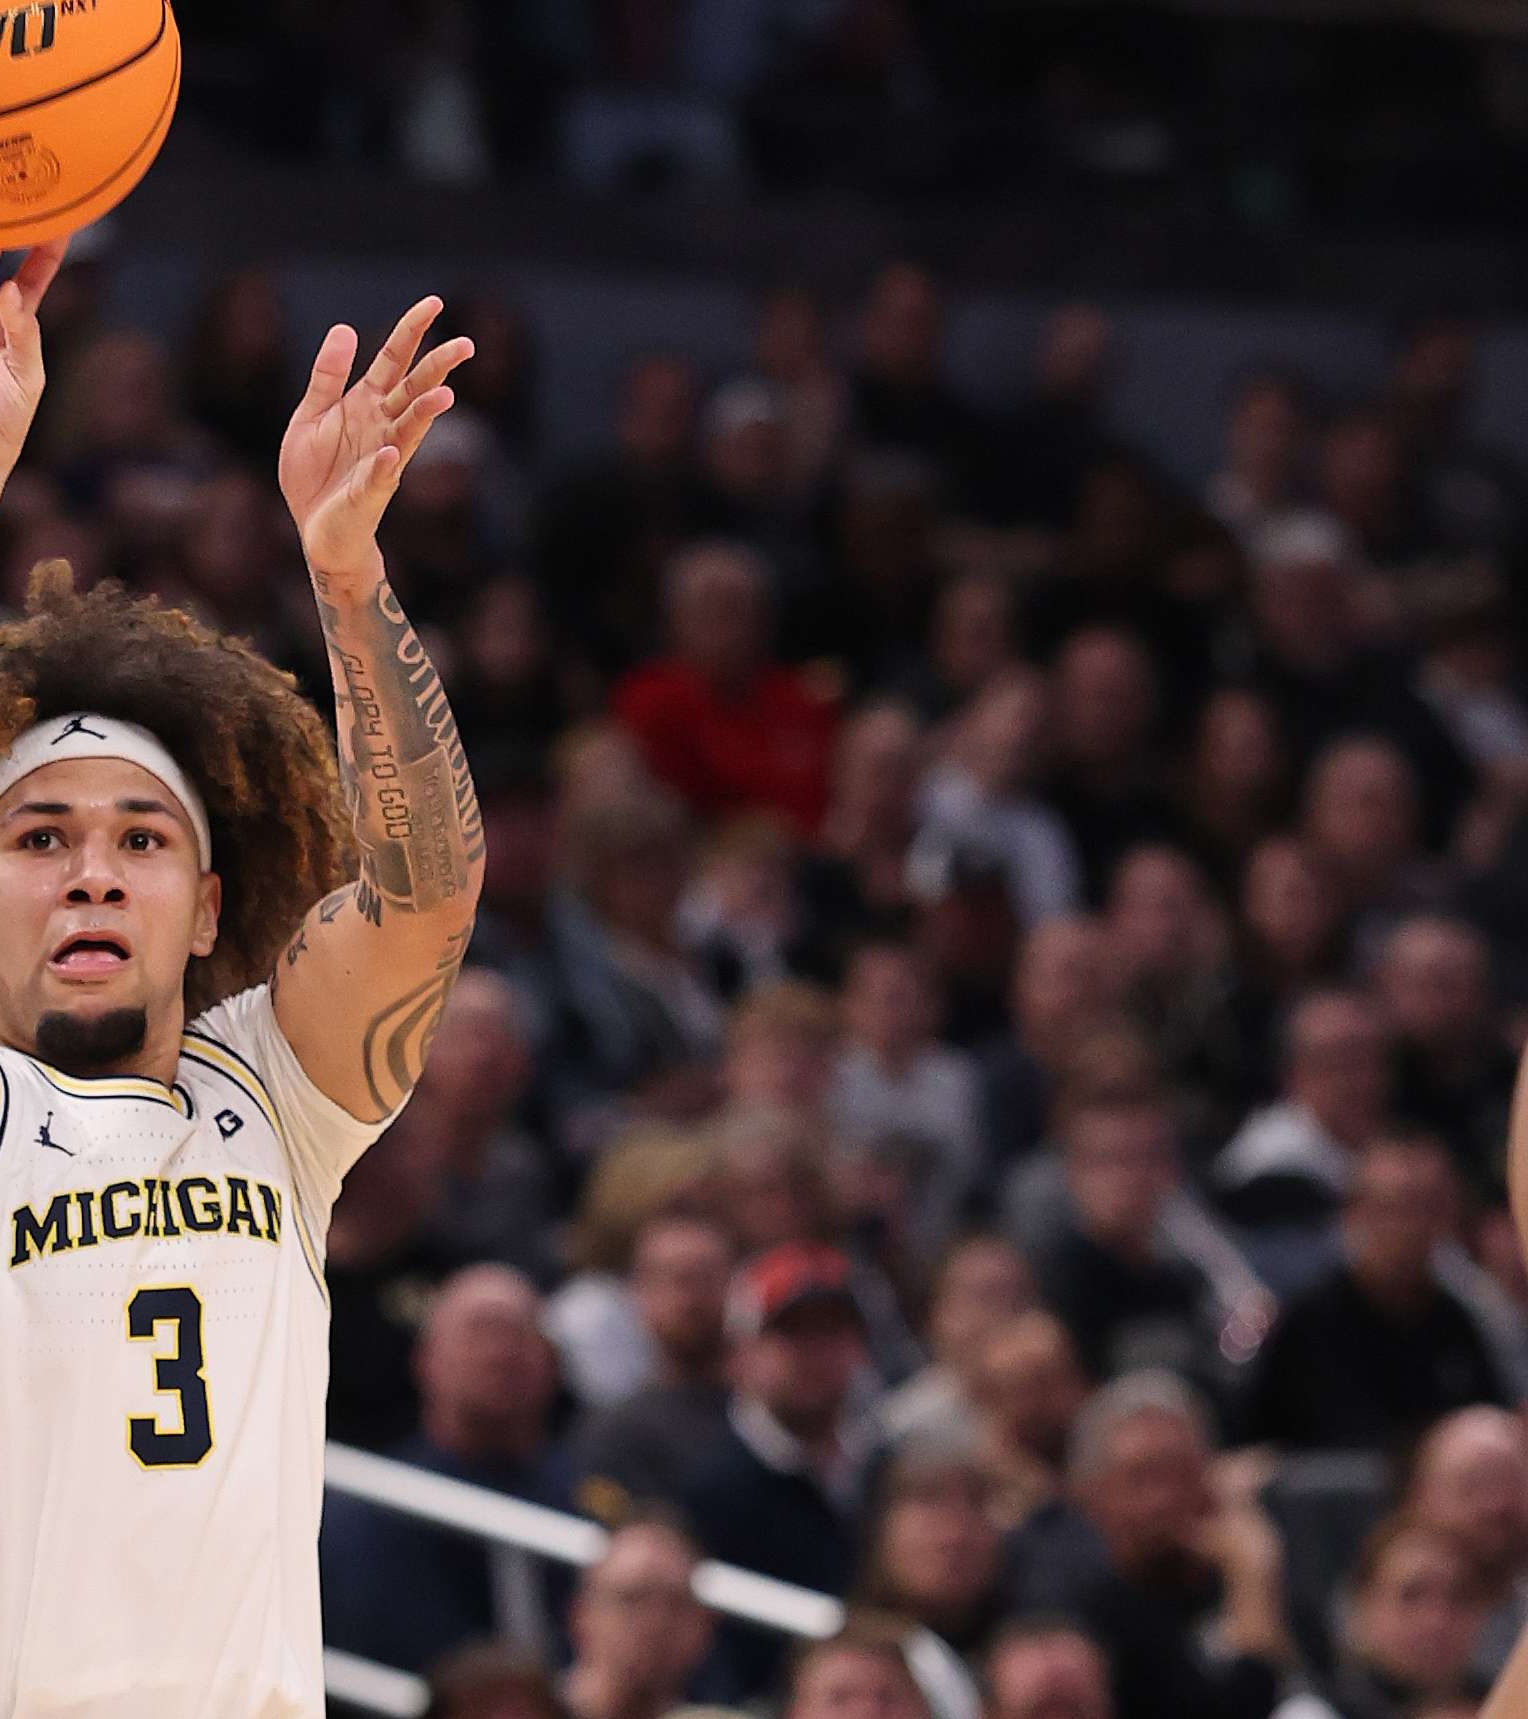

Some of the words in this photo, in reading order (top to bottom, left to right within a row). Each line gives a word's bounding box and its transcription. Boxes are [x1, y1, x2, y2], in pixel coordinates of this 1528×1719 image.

[371, 744, 398, 779] TO
[378, 789, 413, 839] GOD
[9, 1173, 282, 1268] MICHIGAN
[125, 1282, 216, 1471] 3
